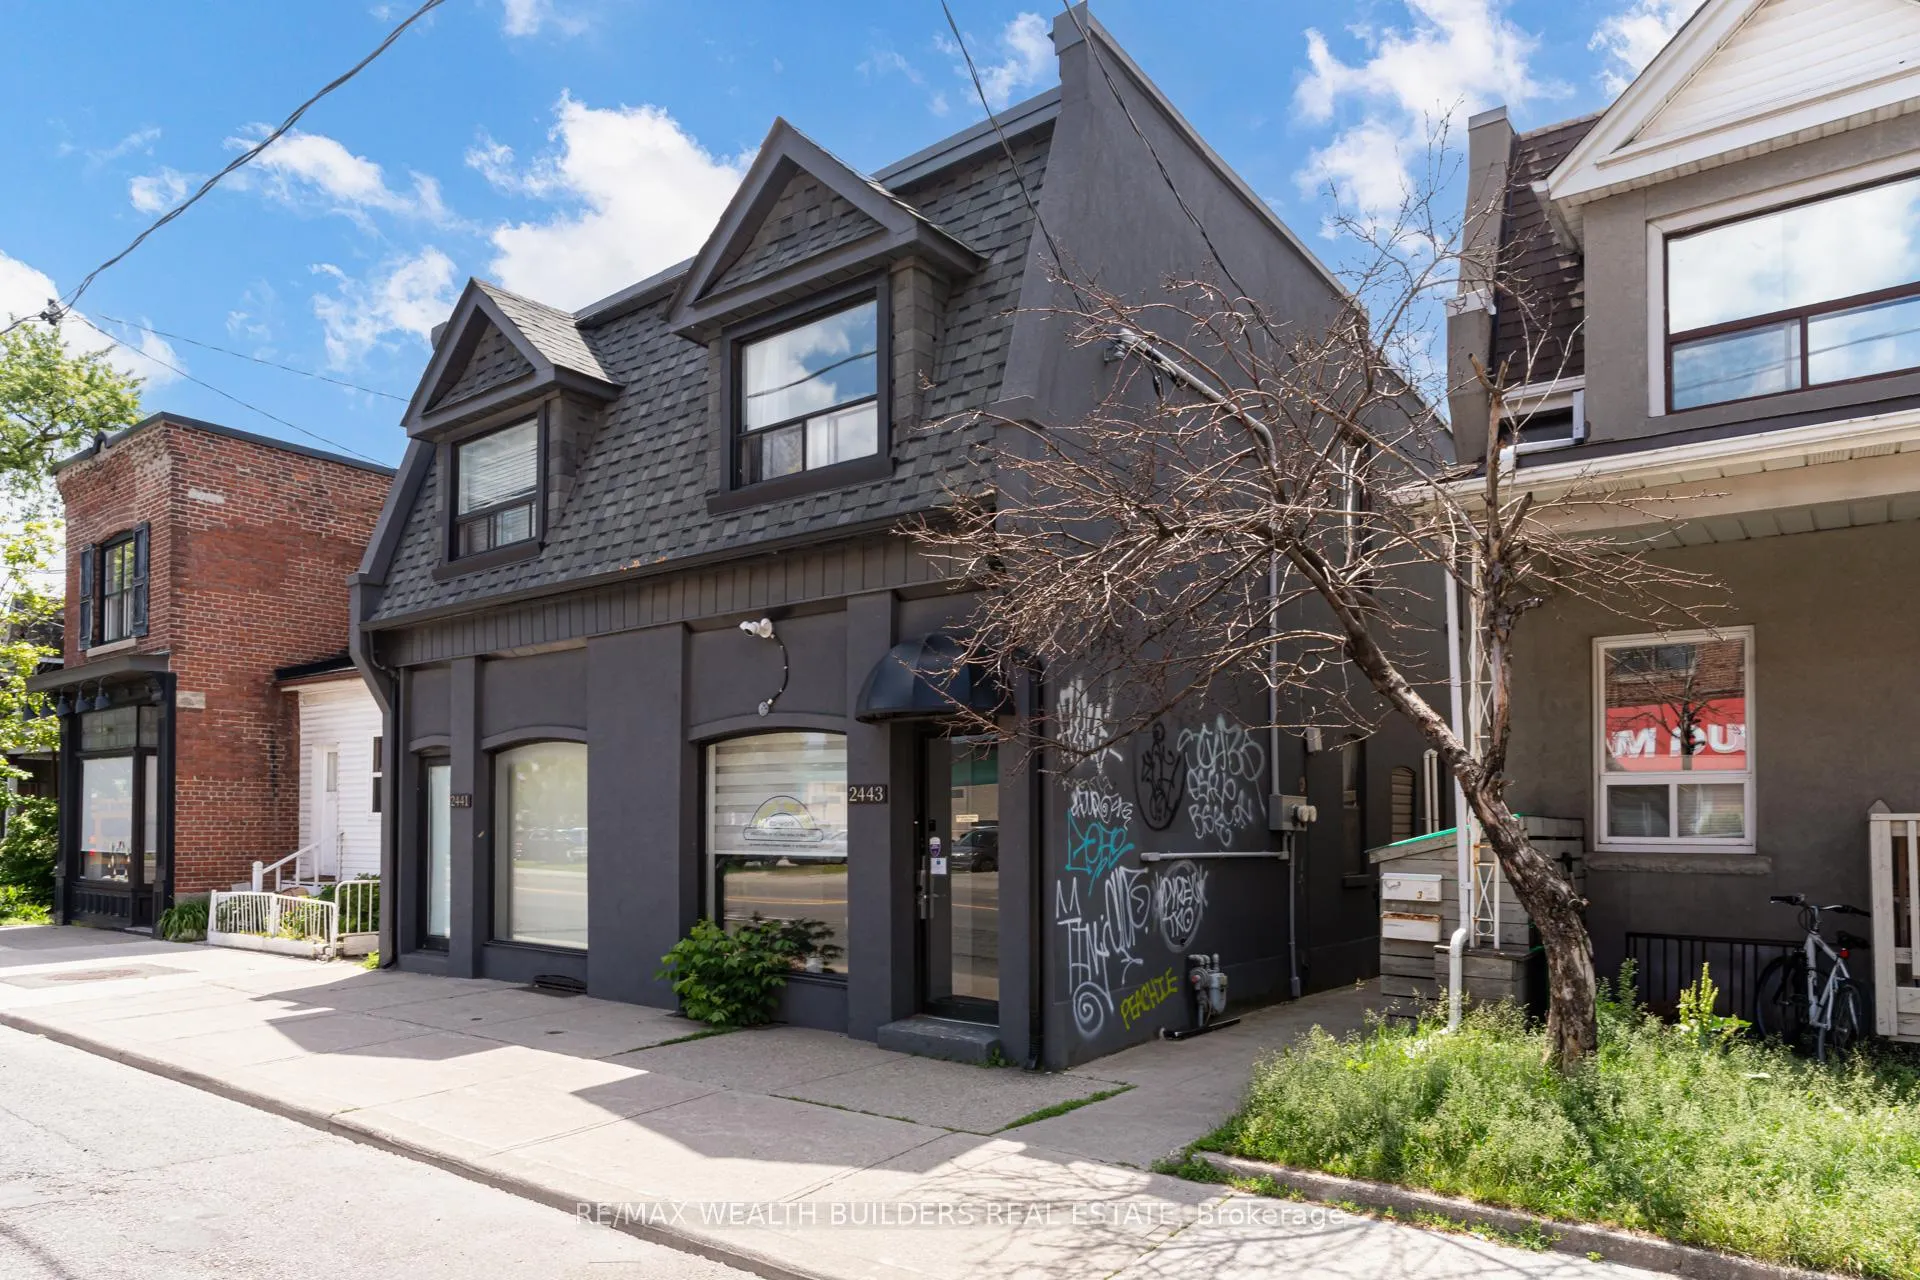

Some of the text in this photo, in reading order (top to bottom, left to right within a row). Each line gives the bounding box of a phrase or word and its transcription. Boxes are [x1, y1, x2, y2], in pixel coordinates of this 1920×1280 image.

[449, 795, 469, 807] 2441
[849, 786, 884, 802] 2443
[1120, 967, 1179, 1031] PEACHIE
